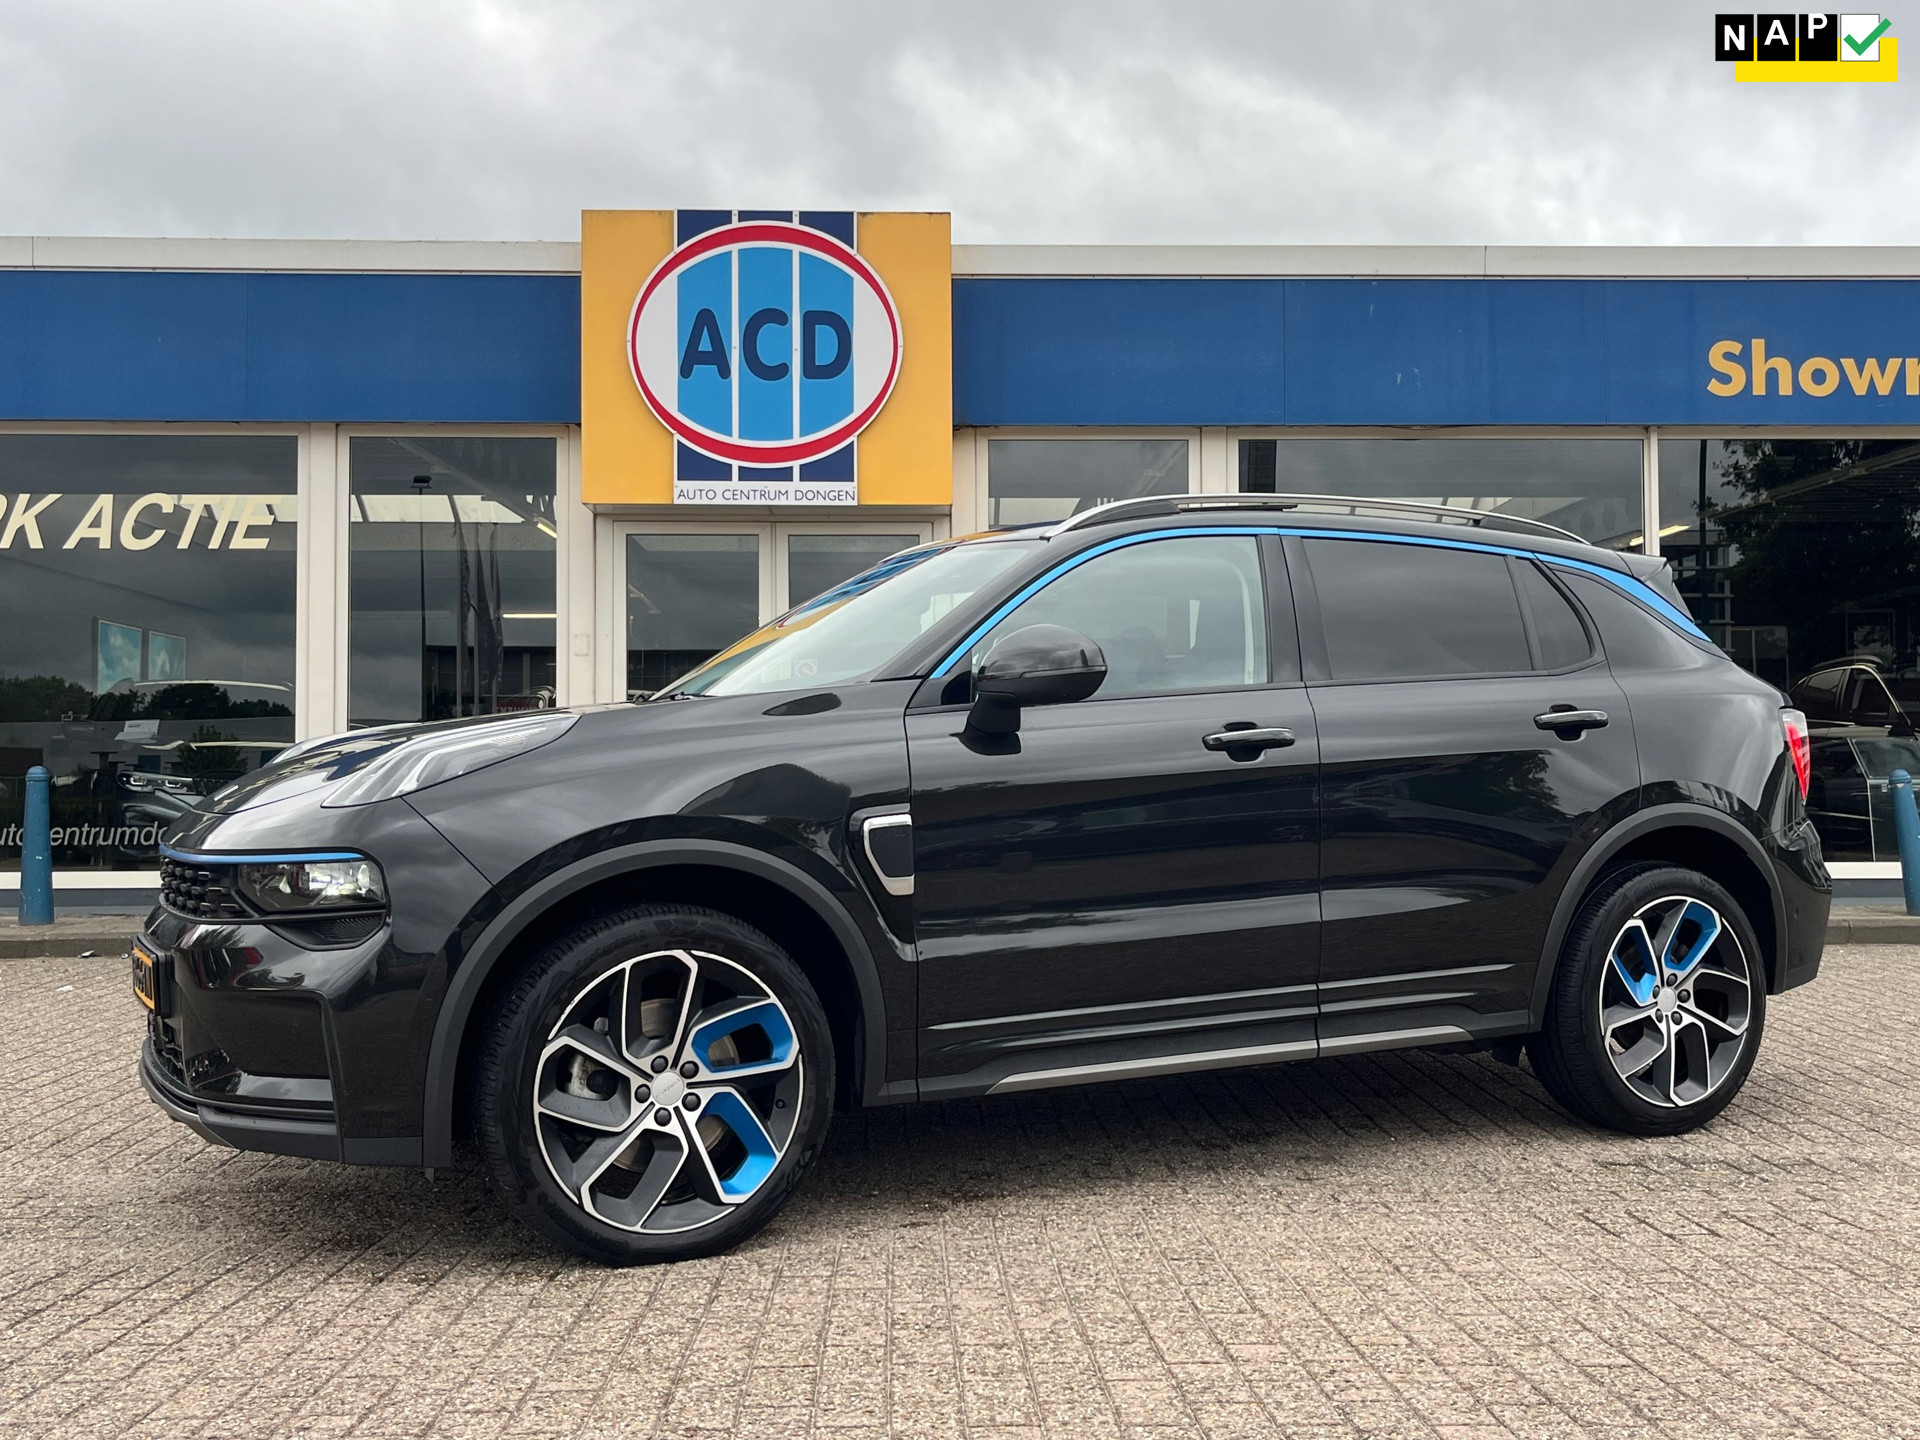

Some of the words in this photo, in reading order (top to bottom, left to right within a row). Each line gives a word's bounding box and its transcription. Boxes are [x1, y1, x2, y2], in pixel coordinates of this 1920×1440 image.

[679, 307, 852, 382] ACD
[62, 492, 285, 551] ACTIE
[677, 489, 717, 501] AUTO
[721, 489, 789, 501] CENTRUM
[794, 489, 856, 501] DONGEN
